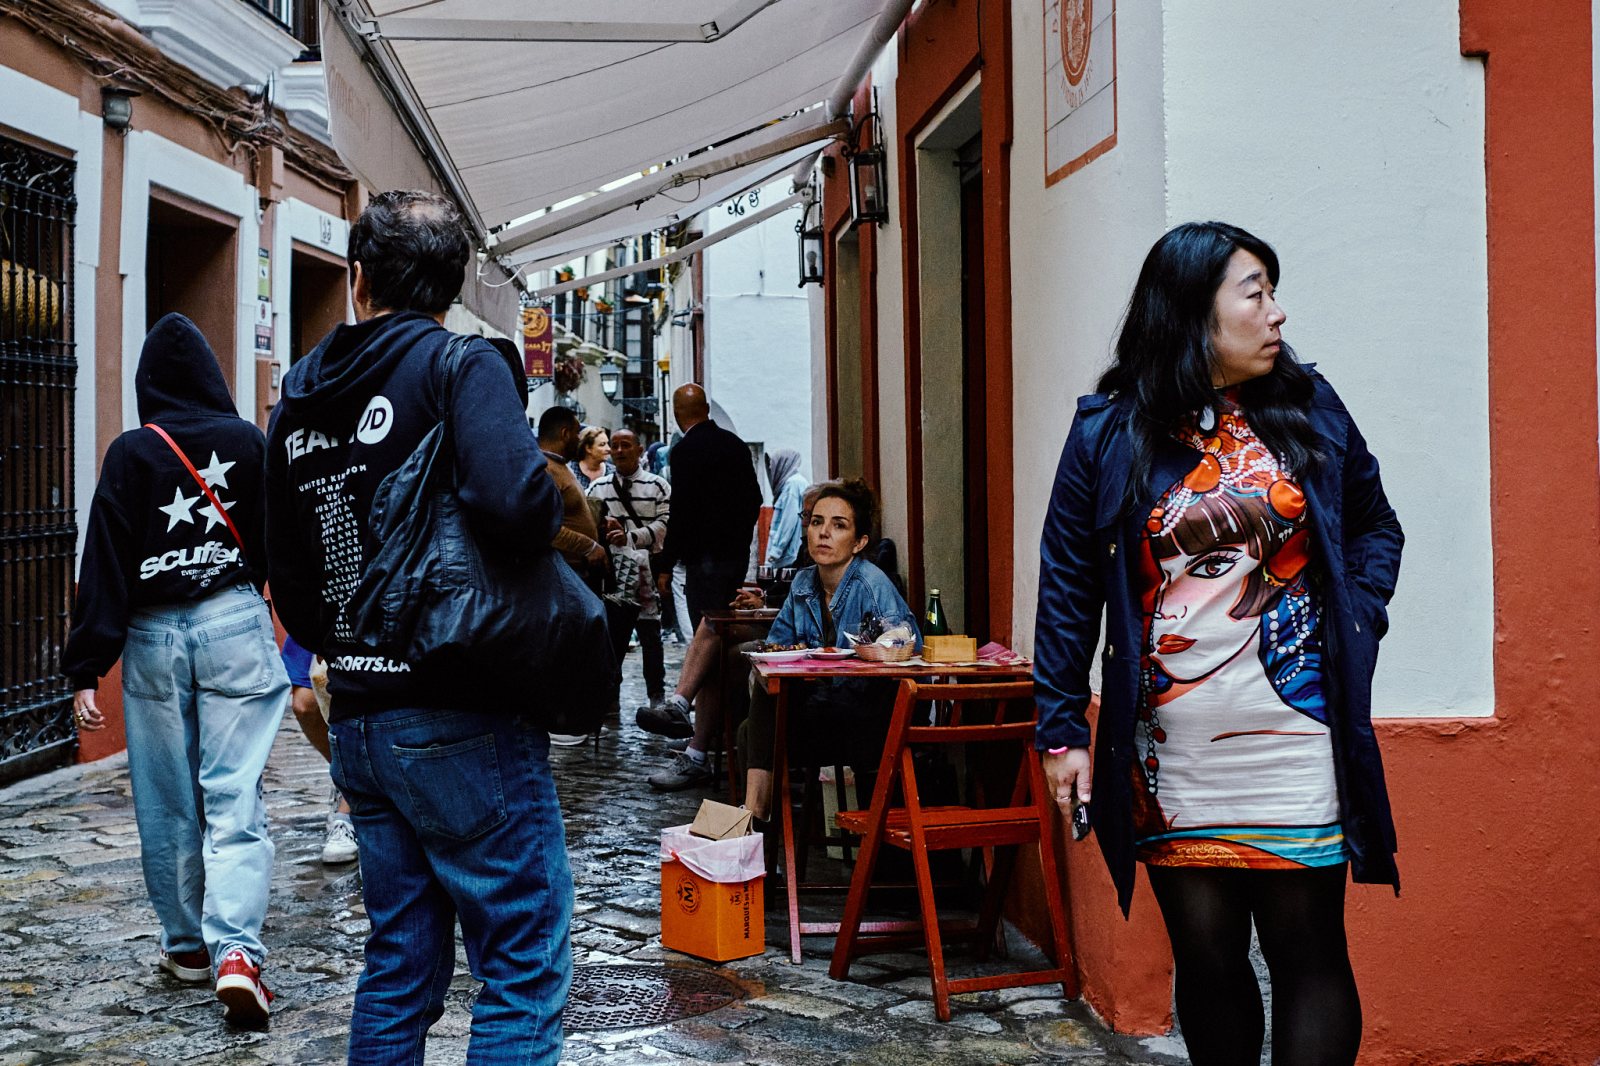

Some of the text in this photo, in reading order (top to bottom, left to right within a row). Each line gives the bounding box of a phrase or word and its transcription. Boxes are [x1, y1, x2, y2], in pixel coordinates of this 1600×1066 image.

[541, 340, 552, 354] 17
[299, 464, 367, 492] UNITED KINOM
[316, 481, 345, 495] CANA
[325, 537, 359, 553] RANCE
[325, 545, 363, 562] ERMANY
[683, 886, 694, 903] M
